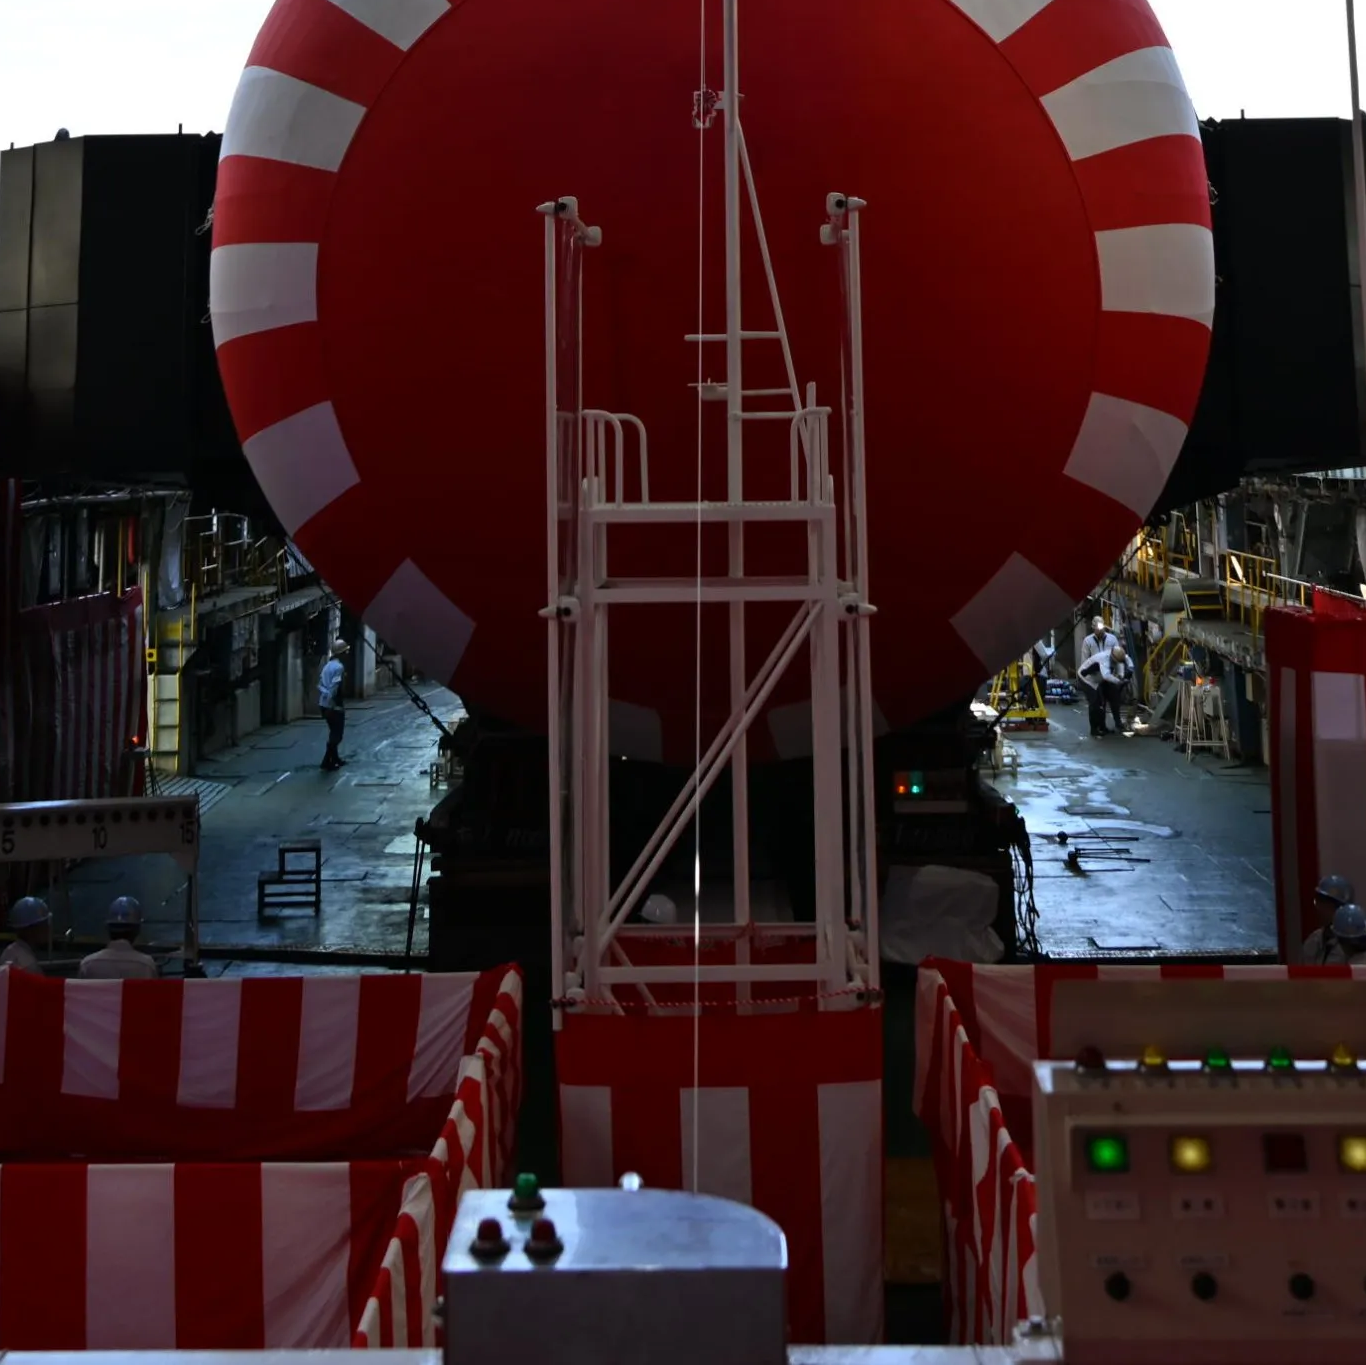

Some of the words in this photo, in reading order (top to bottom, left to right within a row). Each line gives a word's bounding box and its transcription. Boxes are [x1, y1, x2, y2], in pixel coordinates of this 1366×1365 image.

[1, 830, 15, 854] 5
[92, 826, 108, 849] 10
[179, 820, 195, 844] 15
